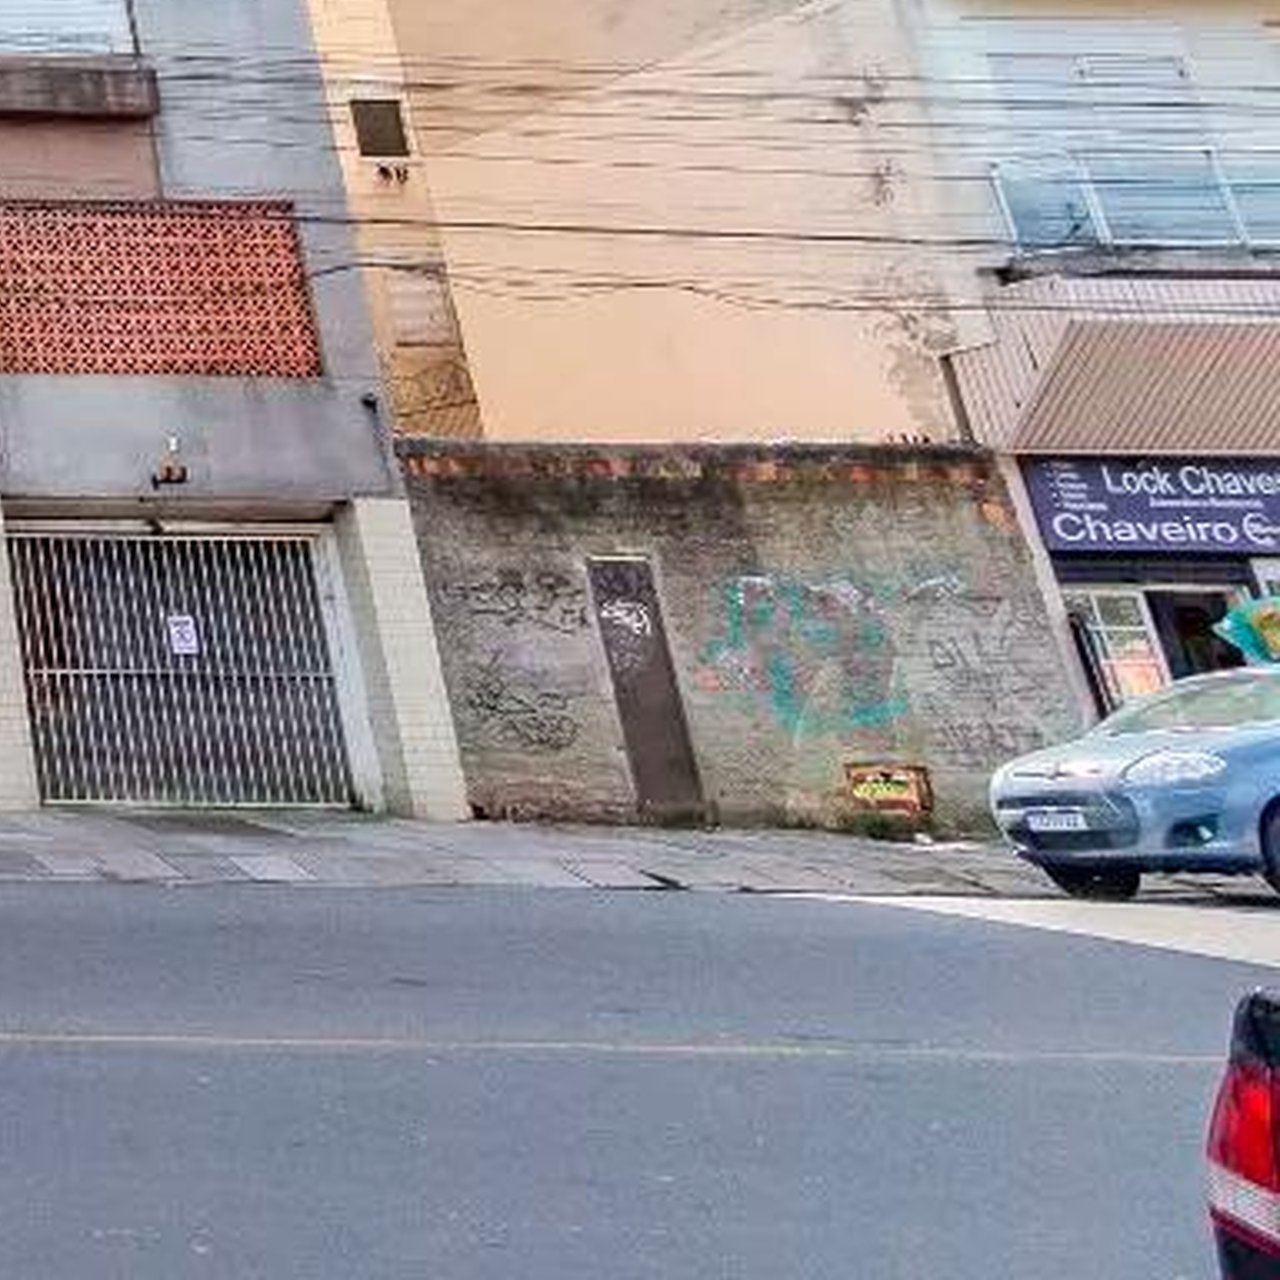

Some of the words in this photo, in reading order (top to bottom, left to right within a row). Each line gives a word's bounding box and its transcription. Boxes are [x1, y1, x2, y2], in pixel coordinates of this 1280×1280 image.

[1100, 465, 1177, 495] Lock
[1178, 465, 1280, 496] Chave
[1051, 512, 1239, 543] Chaveiro
